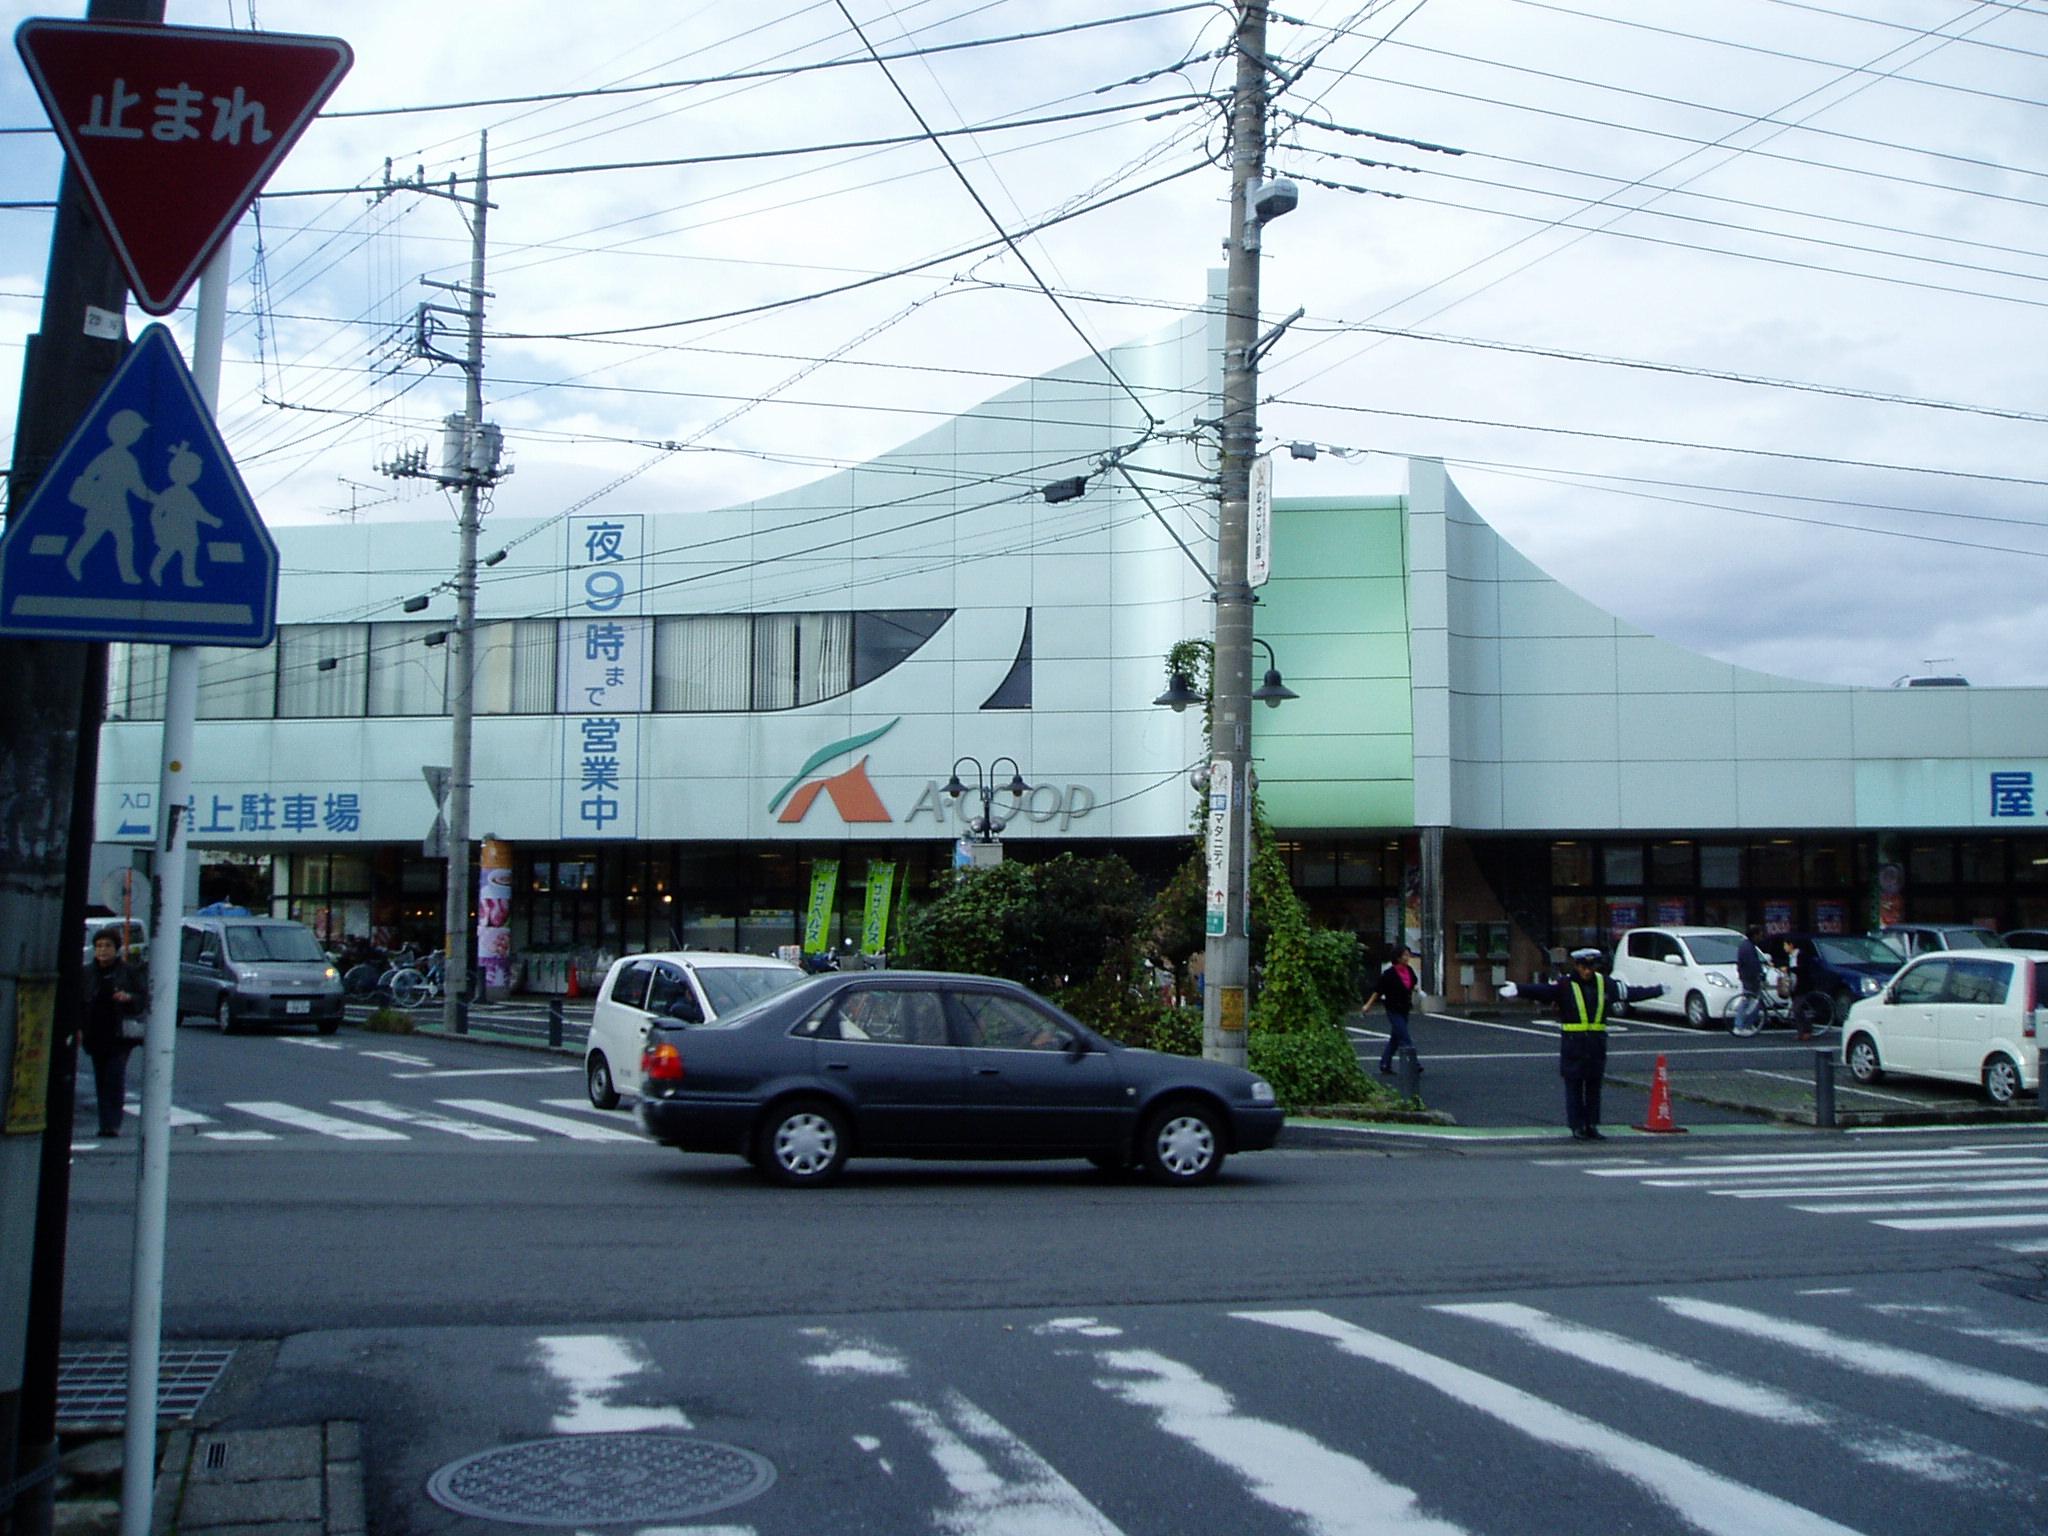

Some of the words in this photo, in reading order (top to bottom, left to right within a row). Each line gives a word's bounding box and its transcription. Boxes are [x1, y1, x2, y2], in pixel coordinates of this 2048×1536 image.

[79, 77, 272, 145] 止まれ
[120, 793, 150, 809] 入口
[187, 792, 361, 833] 上駐車場
[1990, 771, 2048, 818] 屋
[1212, 812, 1225, 871] マタニティ
